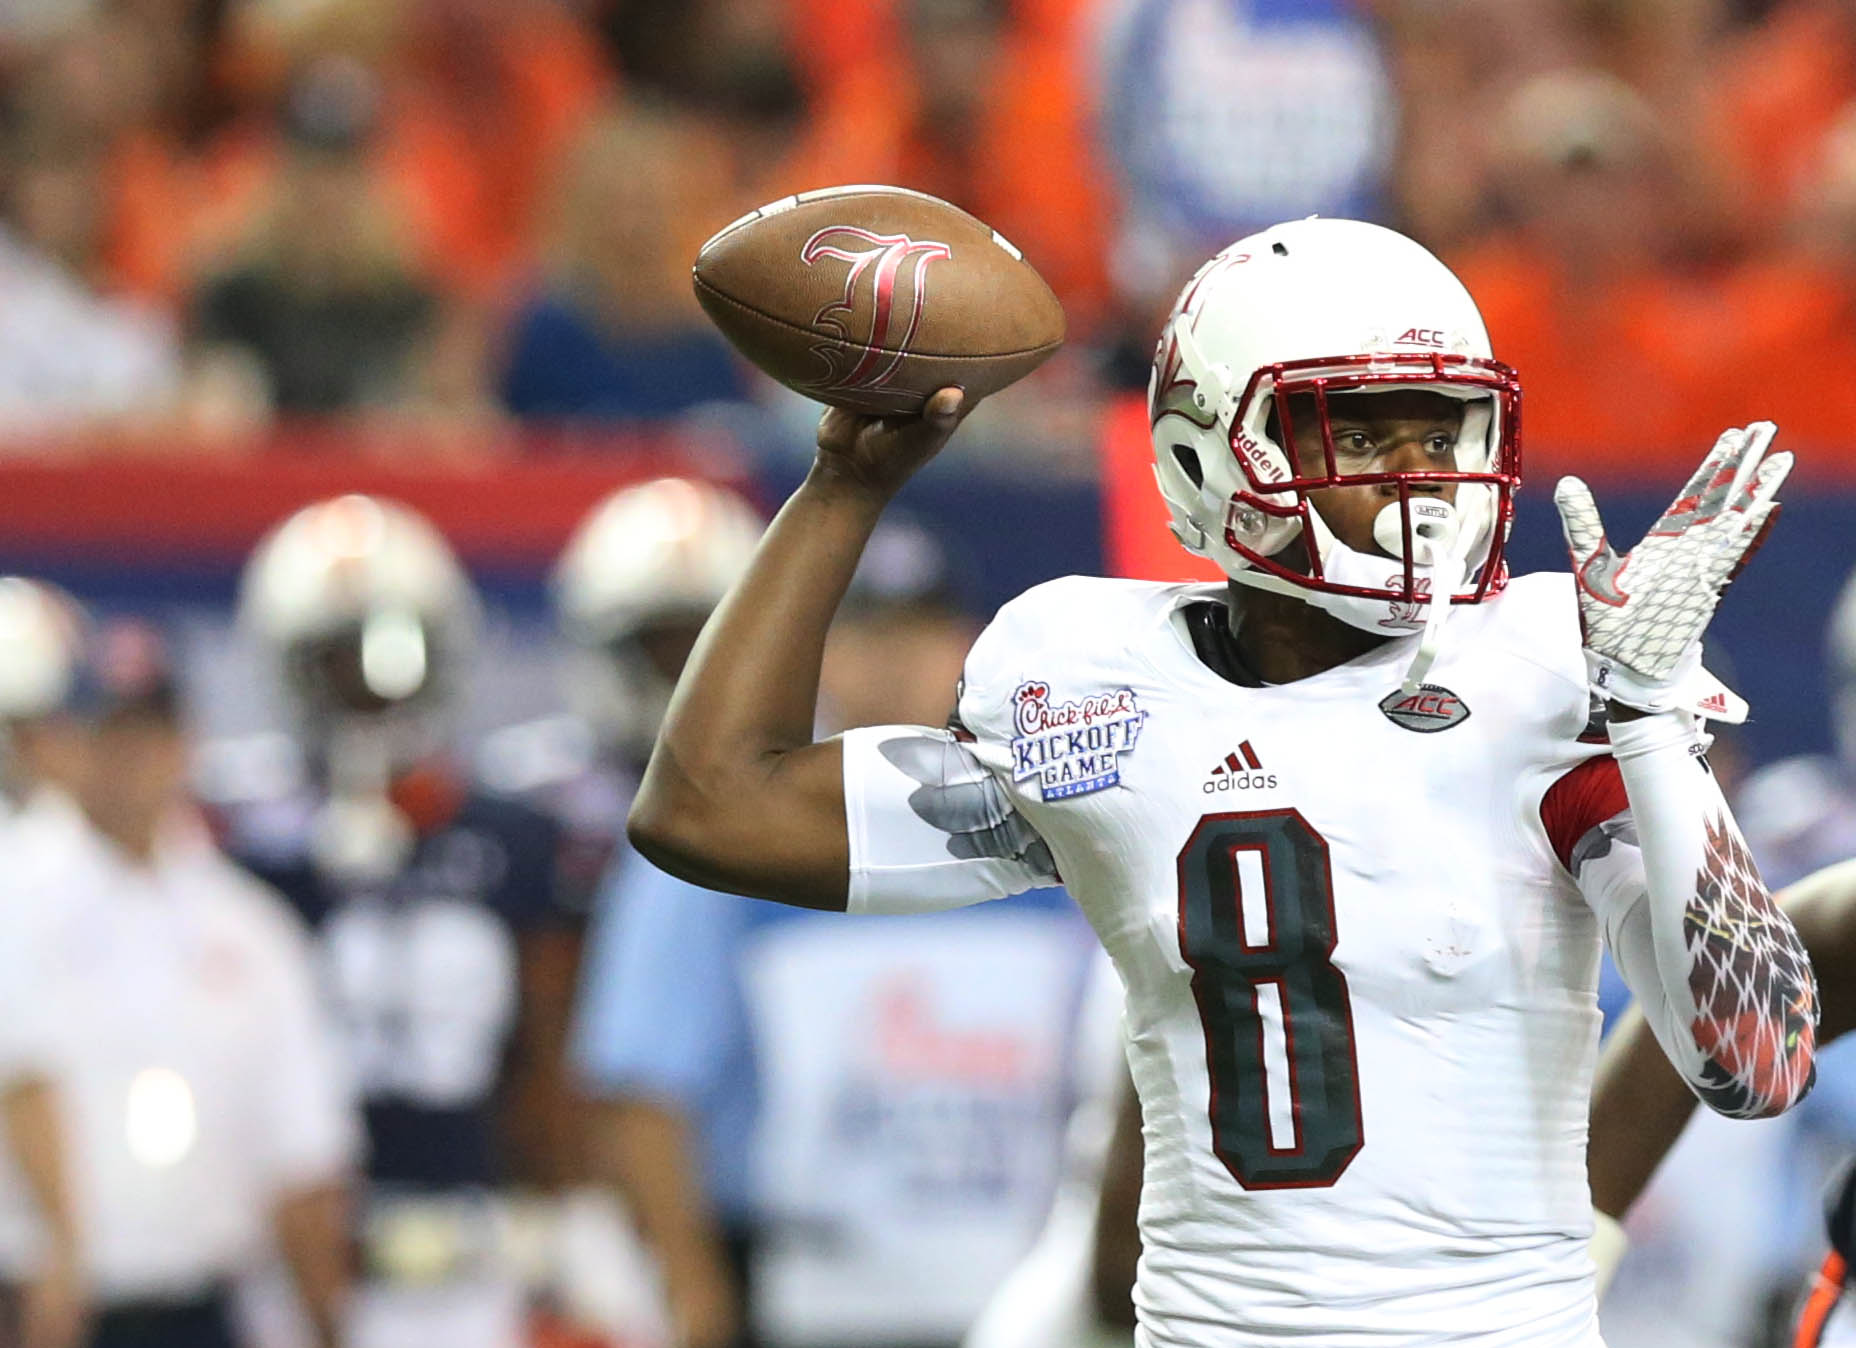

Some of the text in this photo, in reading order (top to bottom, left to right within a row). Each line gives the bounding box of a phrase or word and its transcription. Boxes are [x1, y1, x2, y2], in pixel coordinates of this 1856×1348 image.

[1397, 327, 1446, 345] ACC
[1020, 694, 1131, 735] Chick-fil-A
[1393, 695, 1459, 716] ACC
[1016, 716, 1141, 774] KICKOFF
[1044, 754, 1114, 785] GAME
[1203, 771, 1278, 794] adidas
[1177, 806, 1365, 1191] 8
